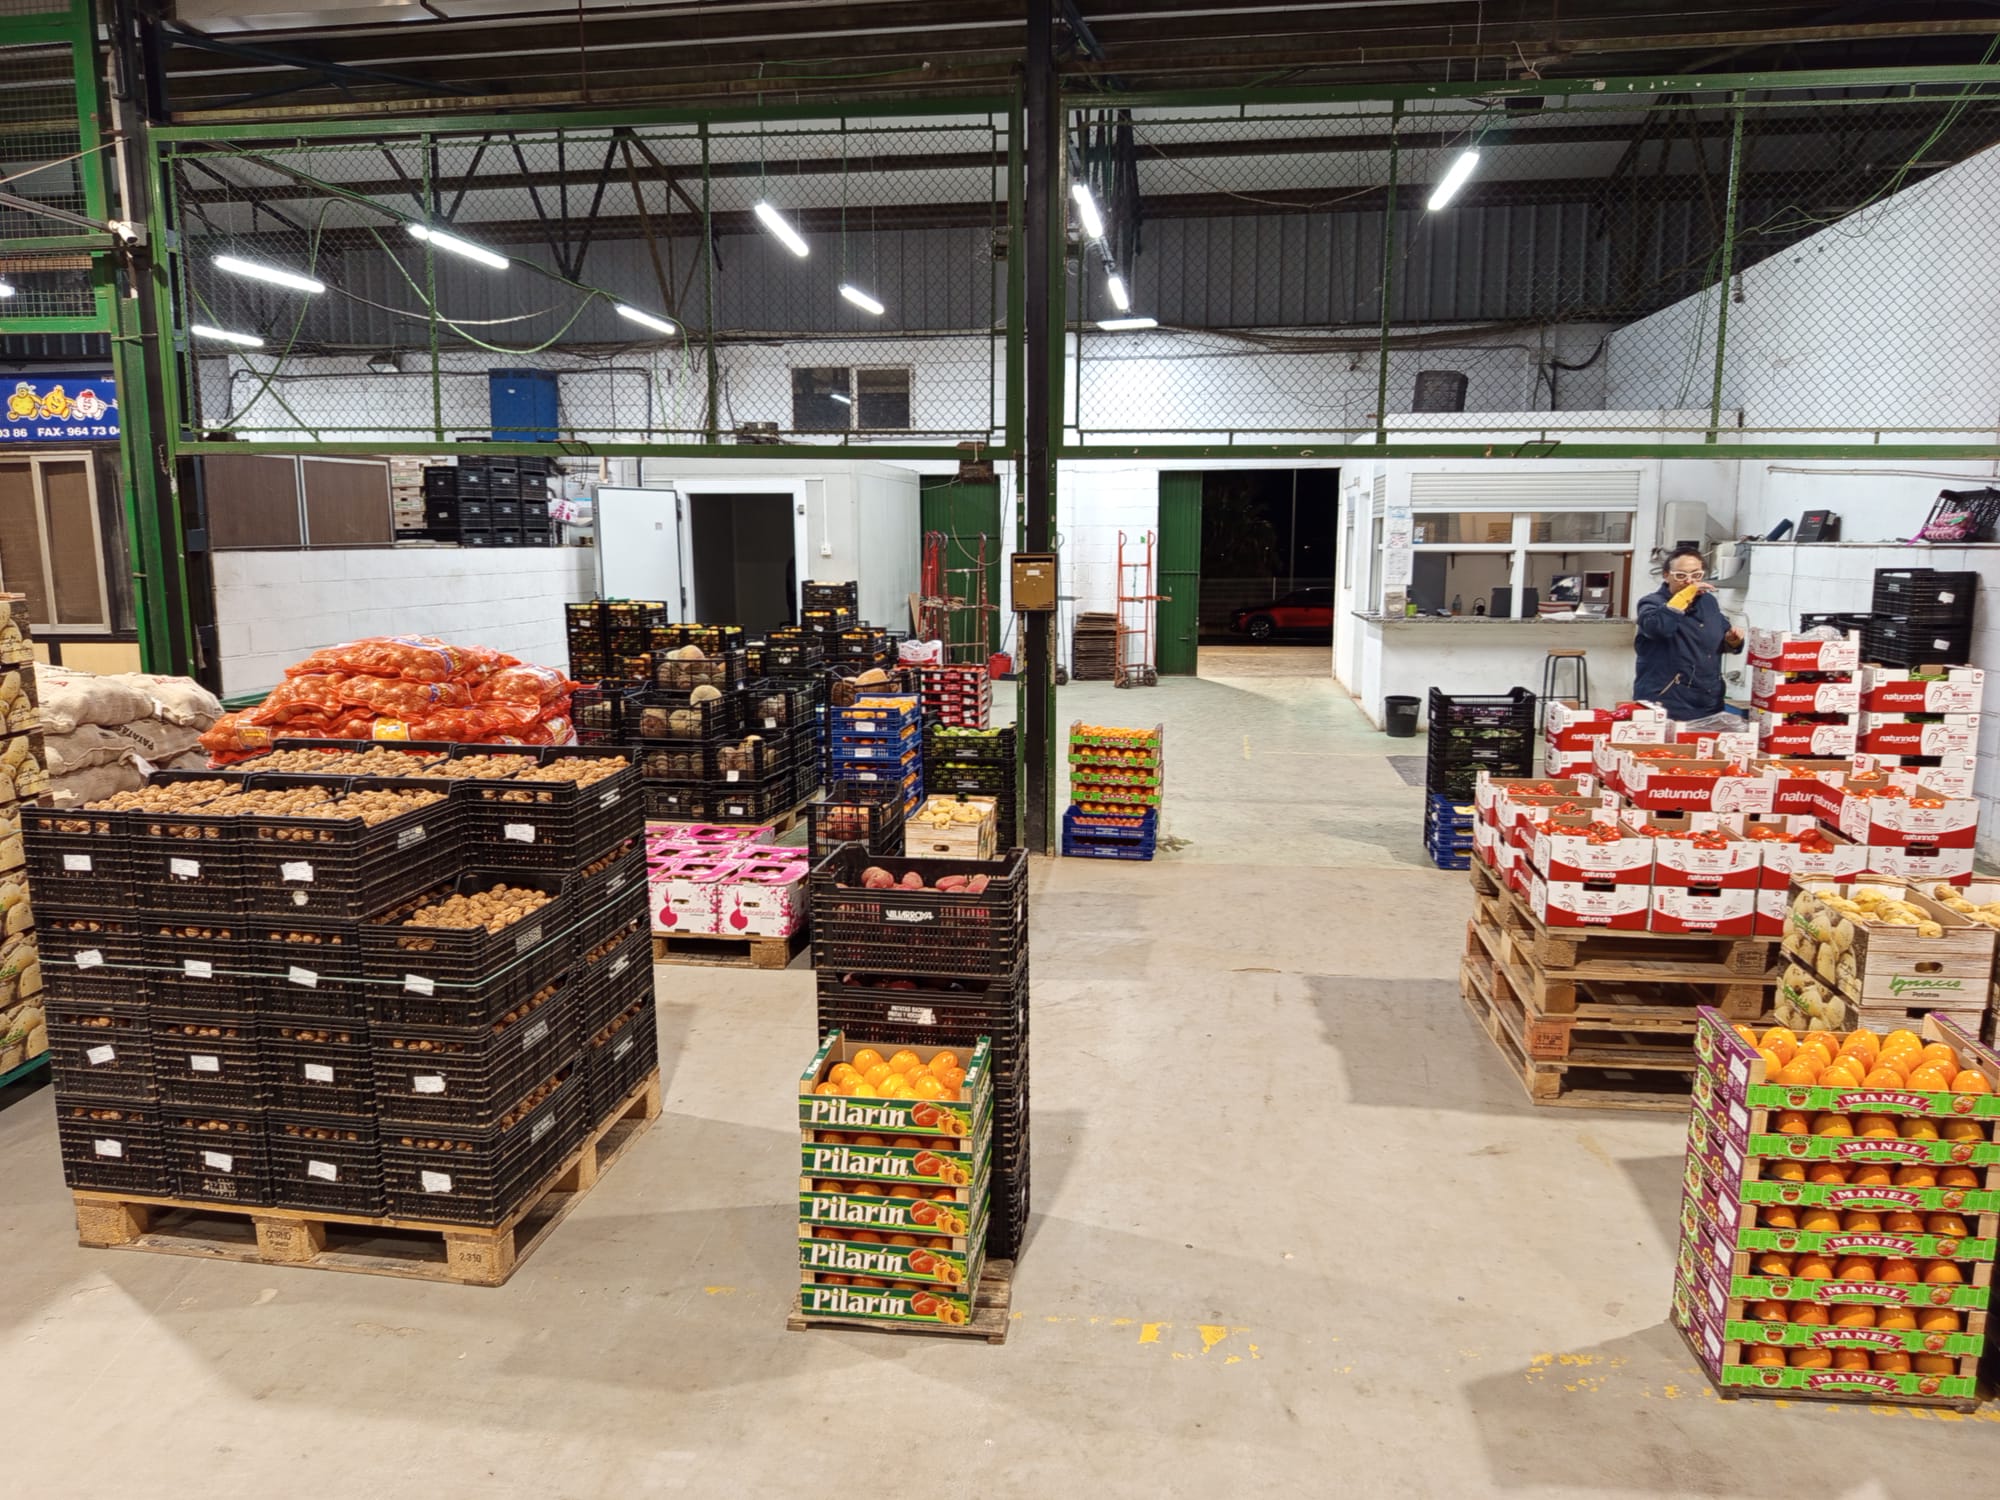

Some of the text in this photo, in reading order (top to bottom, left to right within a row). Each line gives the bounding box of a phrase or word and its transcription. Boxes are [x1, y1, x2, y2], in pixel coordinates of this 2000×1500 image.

[13, 428, 28, 437] 86
[37, 427, 64, 437] FAX-
[66, 427, 88, 437] 964
[91, 426, 107, 436] 73
[1843, 1094, 1921, 1107] MANEL
[810, 1099, 906, 1128] Pilarín
[1841, 1142, 1920, 1156] MANEL
[813, 1148, 909, 1177] Pilarín
[1835, 1189, 1913, 1204] MANEL
[811, 1196, 906, 1226] Pilarín
[1831, 1236, 1909, 1251] MANEL
[809, 1243, 904, 1273] Pilarín
[1824, 1284, 1902, 1299] MANEL
[813, 1288, 906, 1315] Pilarín
[1819, 1331, 1898, 1346] MANEL
[1814, 1374, 1891, 1389] MANEL
